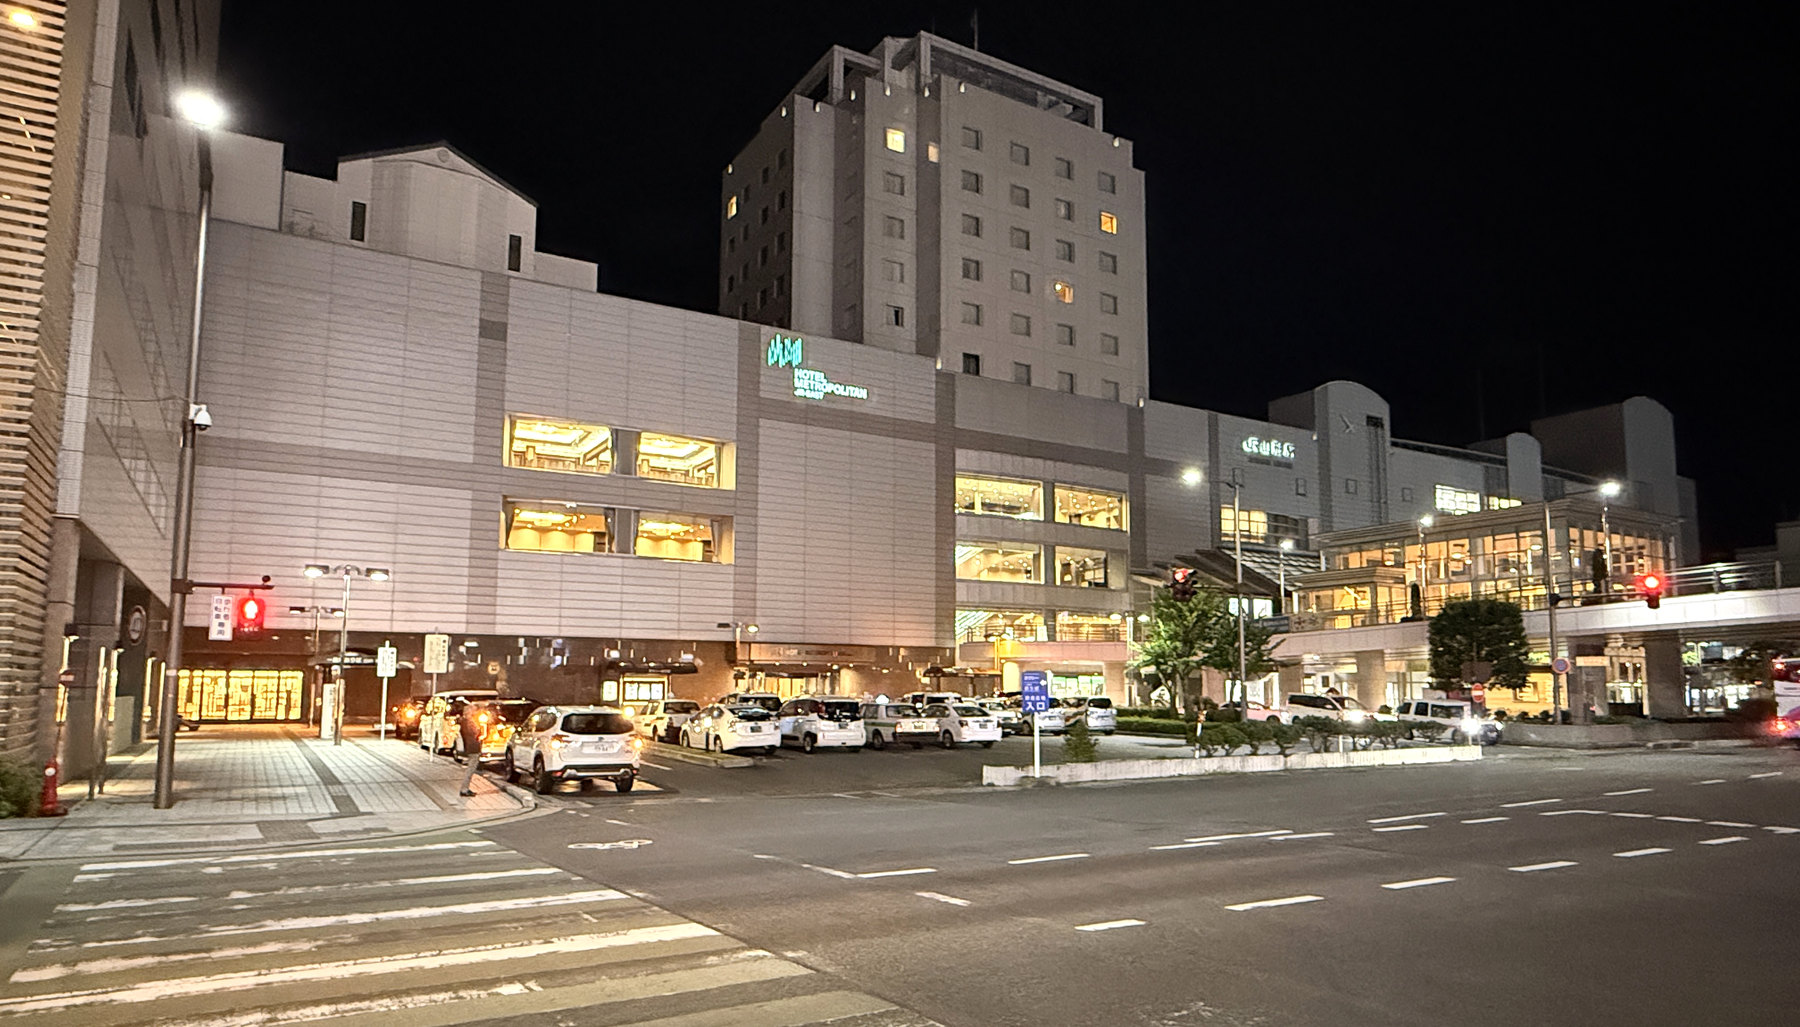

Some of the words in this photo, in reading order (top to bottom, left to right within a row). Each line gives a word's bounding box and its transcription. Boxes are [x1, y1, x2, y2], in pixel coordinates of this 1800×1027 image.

[794, 368, 827, 382] HOTEL
[794, 378, 867, 399] METROPOLITAN
[1025, 701, 1046, 711] 入口
